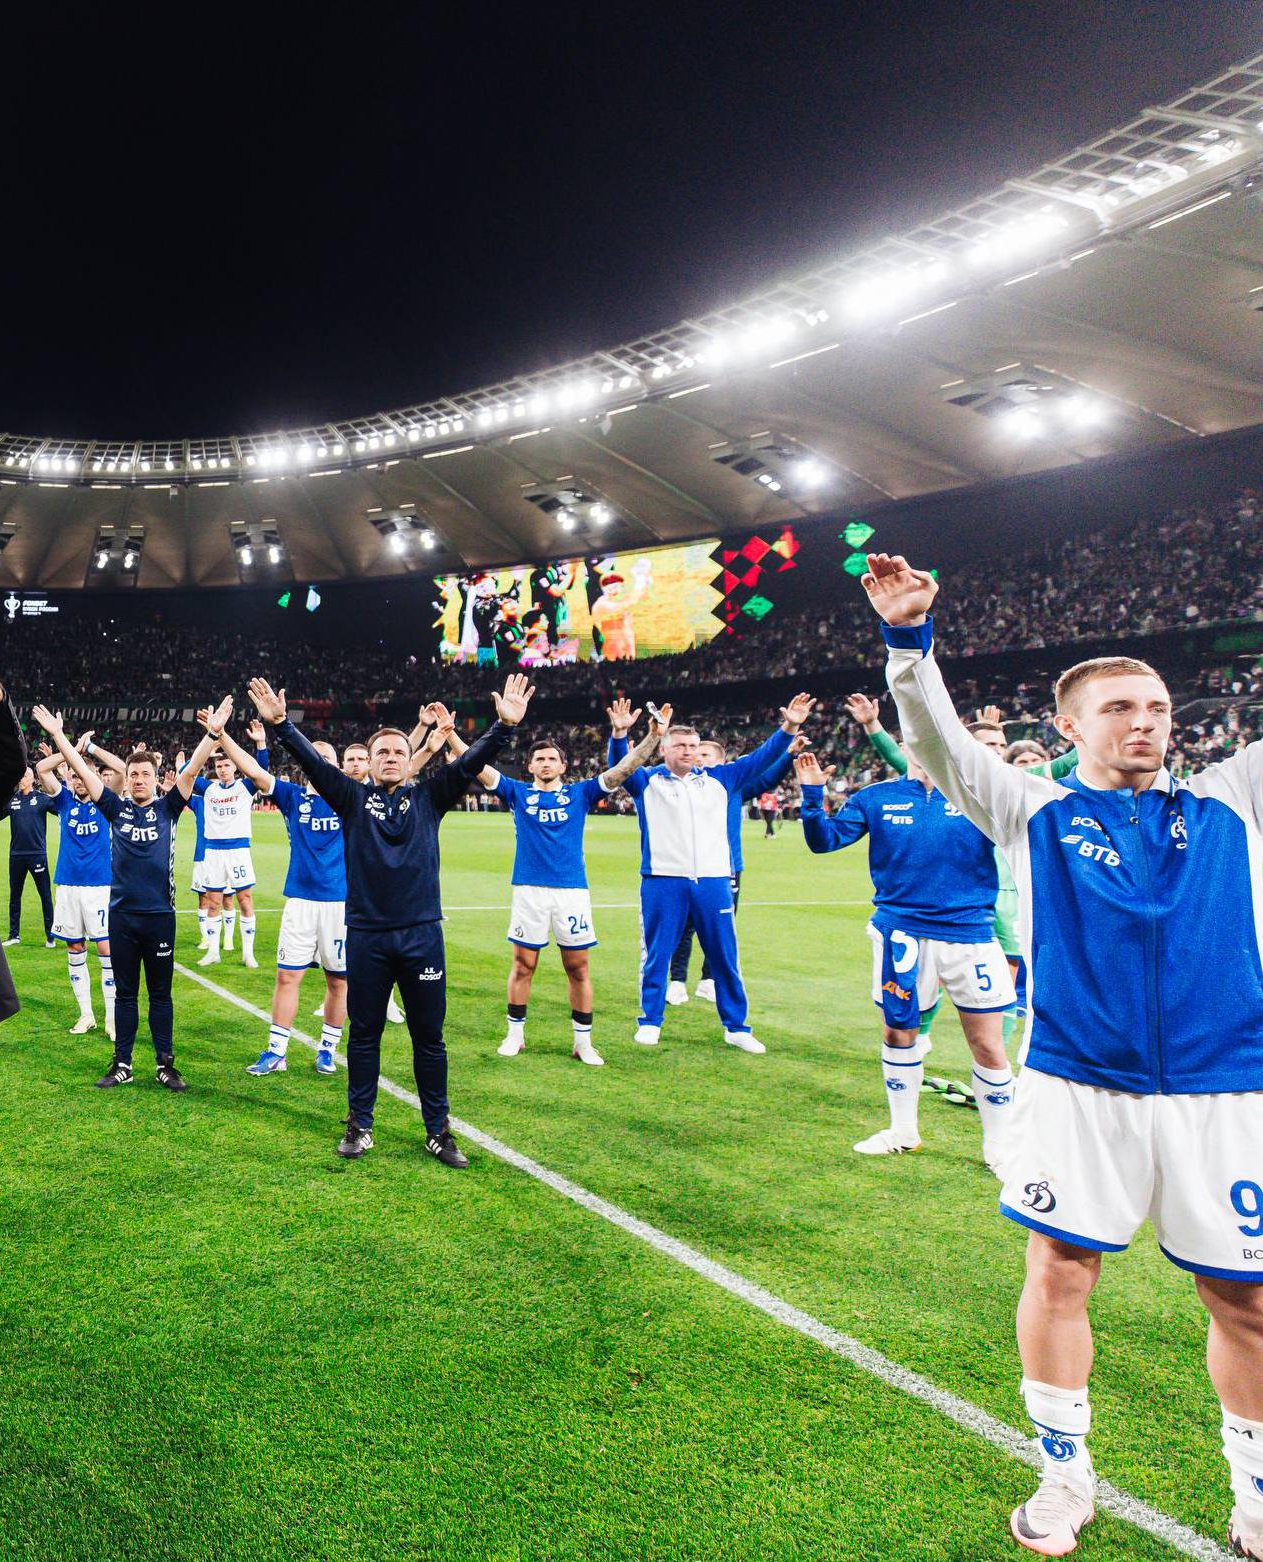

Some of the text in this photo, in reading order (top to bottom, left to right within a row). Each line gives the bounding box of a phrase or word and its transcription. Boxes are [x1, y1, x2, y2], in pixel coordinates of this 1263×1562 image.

[219, 807, 237, 816] ВТБ
[539, 808, 569, 822] ВТБ
[311, 817, 340, 831] ВТБ
[892, 816, 914, 824] ВТБ
[76, 821, 99, 835] ВТБ
[131, 826, 159, 841] ВТБ
[1078, 840, 1121, 867] ВТБ
[232, 865, 246, 879] 56
[568, 914, 589, 935] 24
[419, 973, 441, 981] BOSCO
[974, 963, 992, 992] 5
[1229, 1179, 1263, 1238] 9
